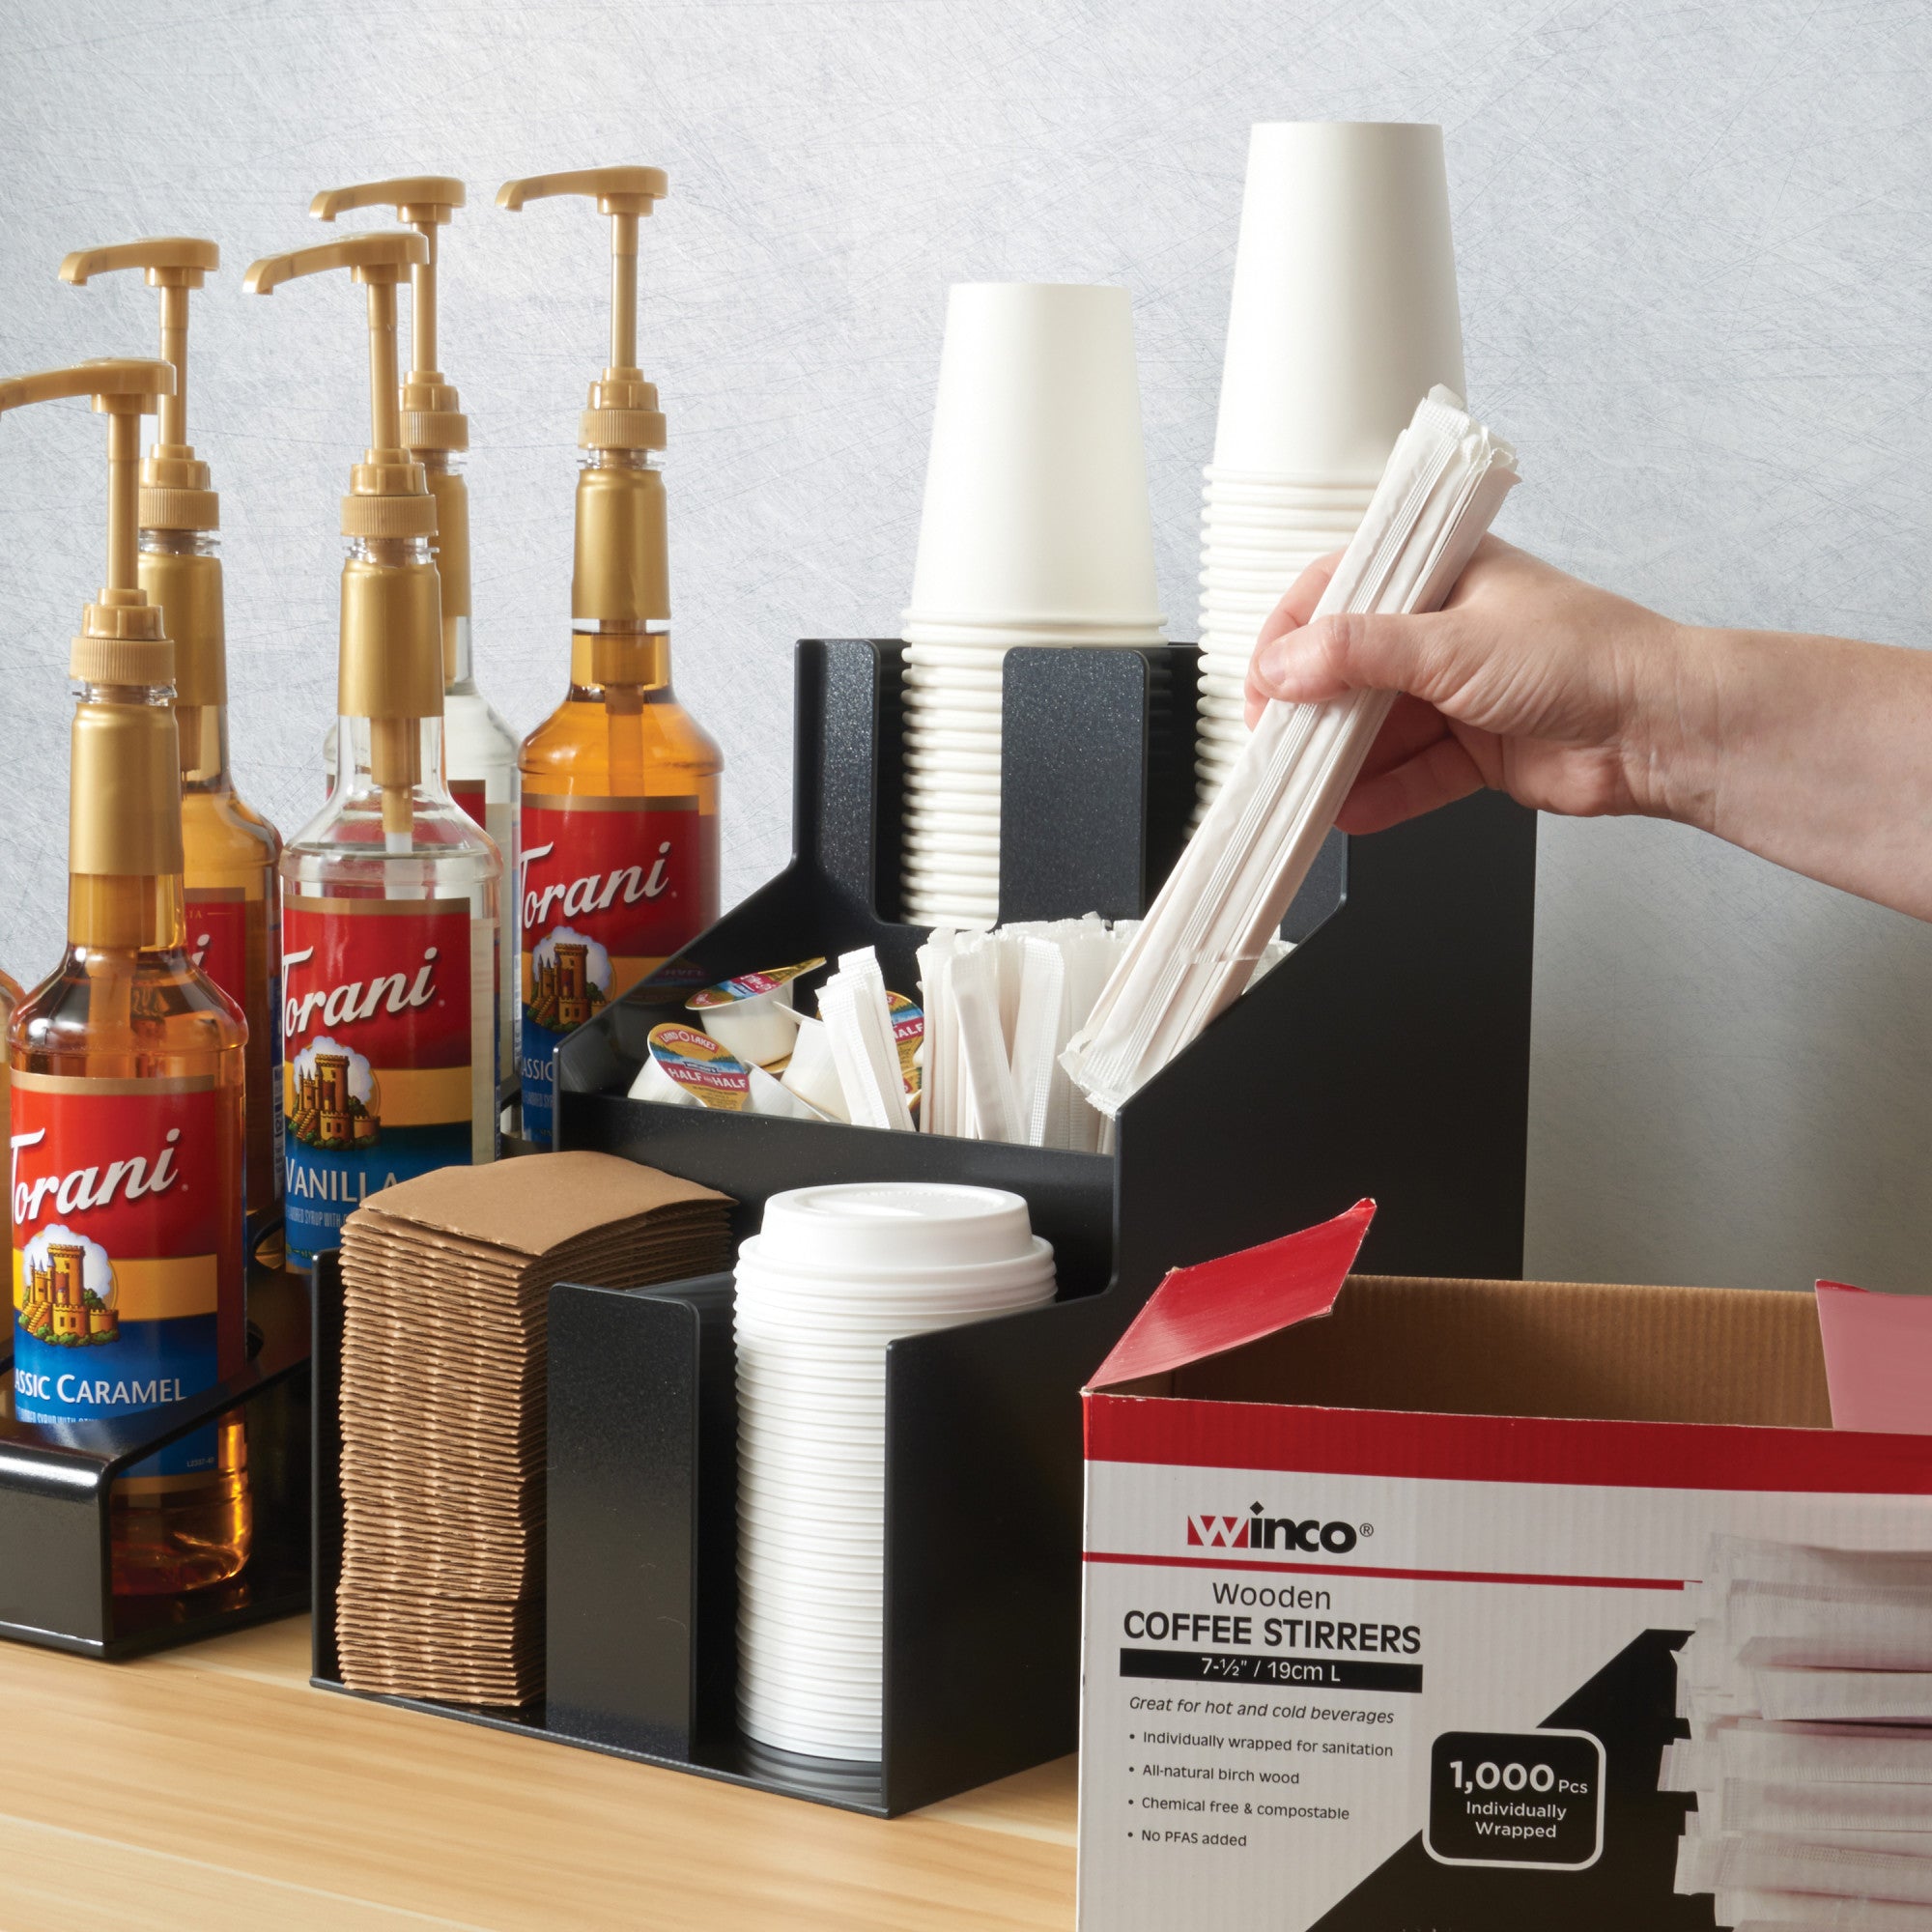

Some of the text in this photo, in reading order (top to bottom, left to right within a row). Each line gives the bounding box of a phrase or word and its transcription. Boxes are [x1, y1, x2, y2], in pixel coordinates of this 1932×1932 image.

[520, 841, 671, 929] Torani
[282, 946, 438, 1037] Torani
[691, 1035, 716, 1051] LAKES
[668, 1067, 702, 1082] HALF
[712, 1076, 747, 1089] HALF
[11, 1126, 181, 1225] Torani
[56, 1374, 187, 1405] CARAMEL
[1212, 1581, 1332, 1610] Wooden
[1123, 1609, 1421, 1655] COFFEE STIRRERS
[1254, 1659, 1262, 1678] /
[1266, 1660, 1323, 1682] 19cm
[1330, 1664, 1341, 1682] L
[1129, 1696, 1395, 1724] Great for hot and cold beverages
[1143, 1731, 1394, 1757] Individually wrapped for sanitation
[1142, 1764, 1300, 1785] All-natural birch wood
[1450, 1760, 1588, 1795] 1,000 Pcs
[1142, 1797, 1350, 1820] Chemical free & compostable
[1465, 1801, 1568, 1821] Individually
[1141, 1830, 1248, 1847] No PFAS added
[1475, 1821, 1557, 1839] Wrapped
